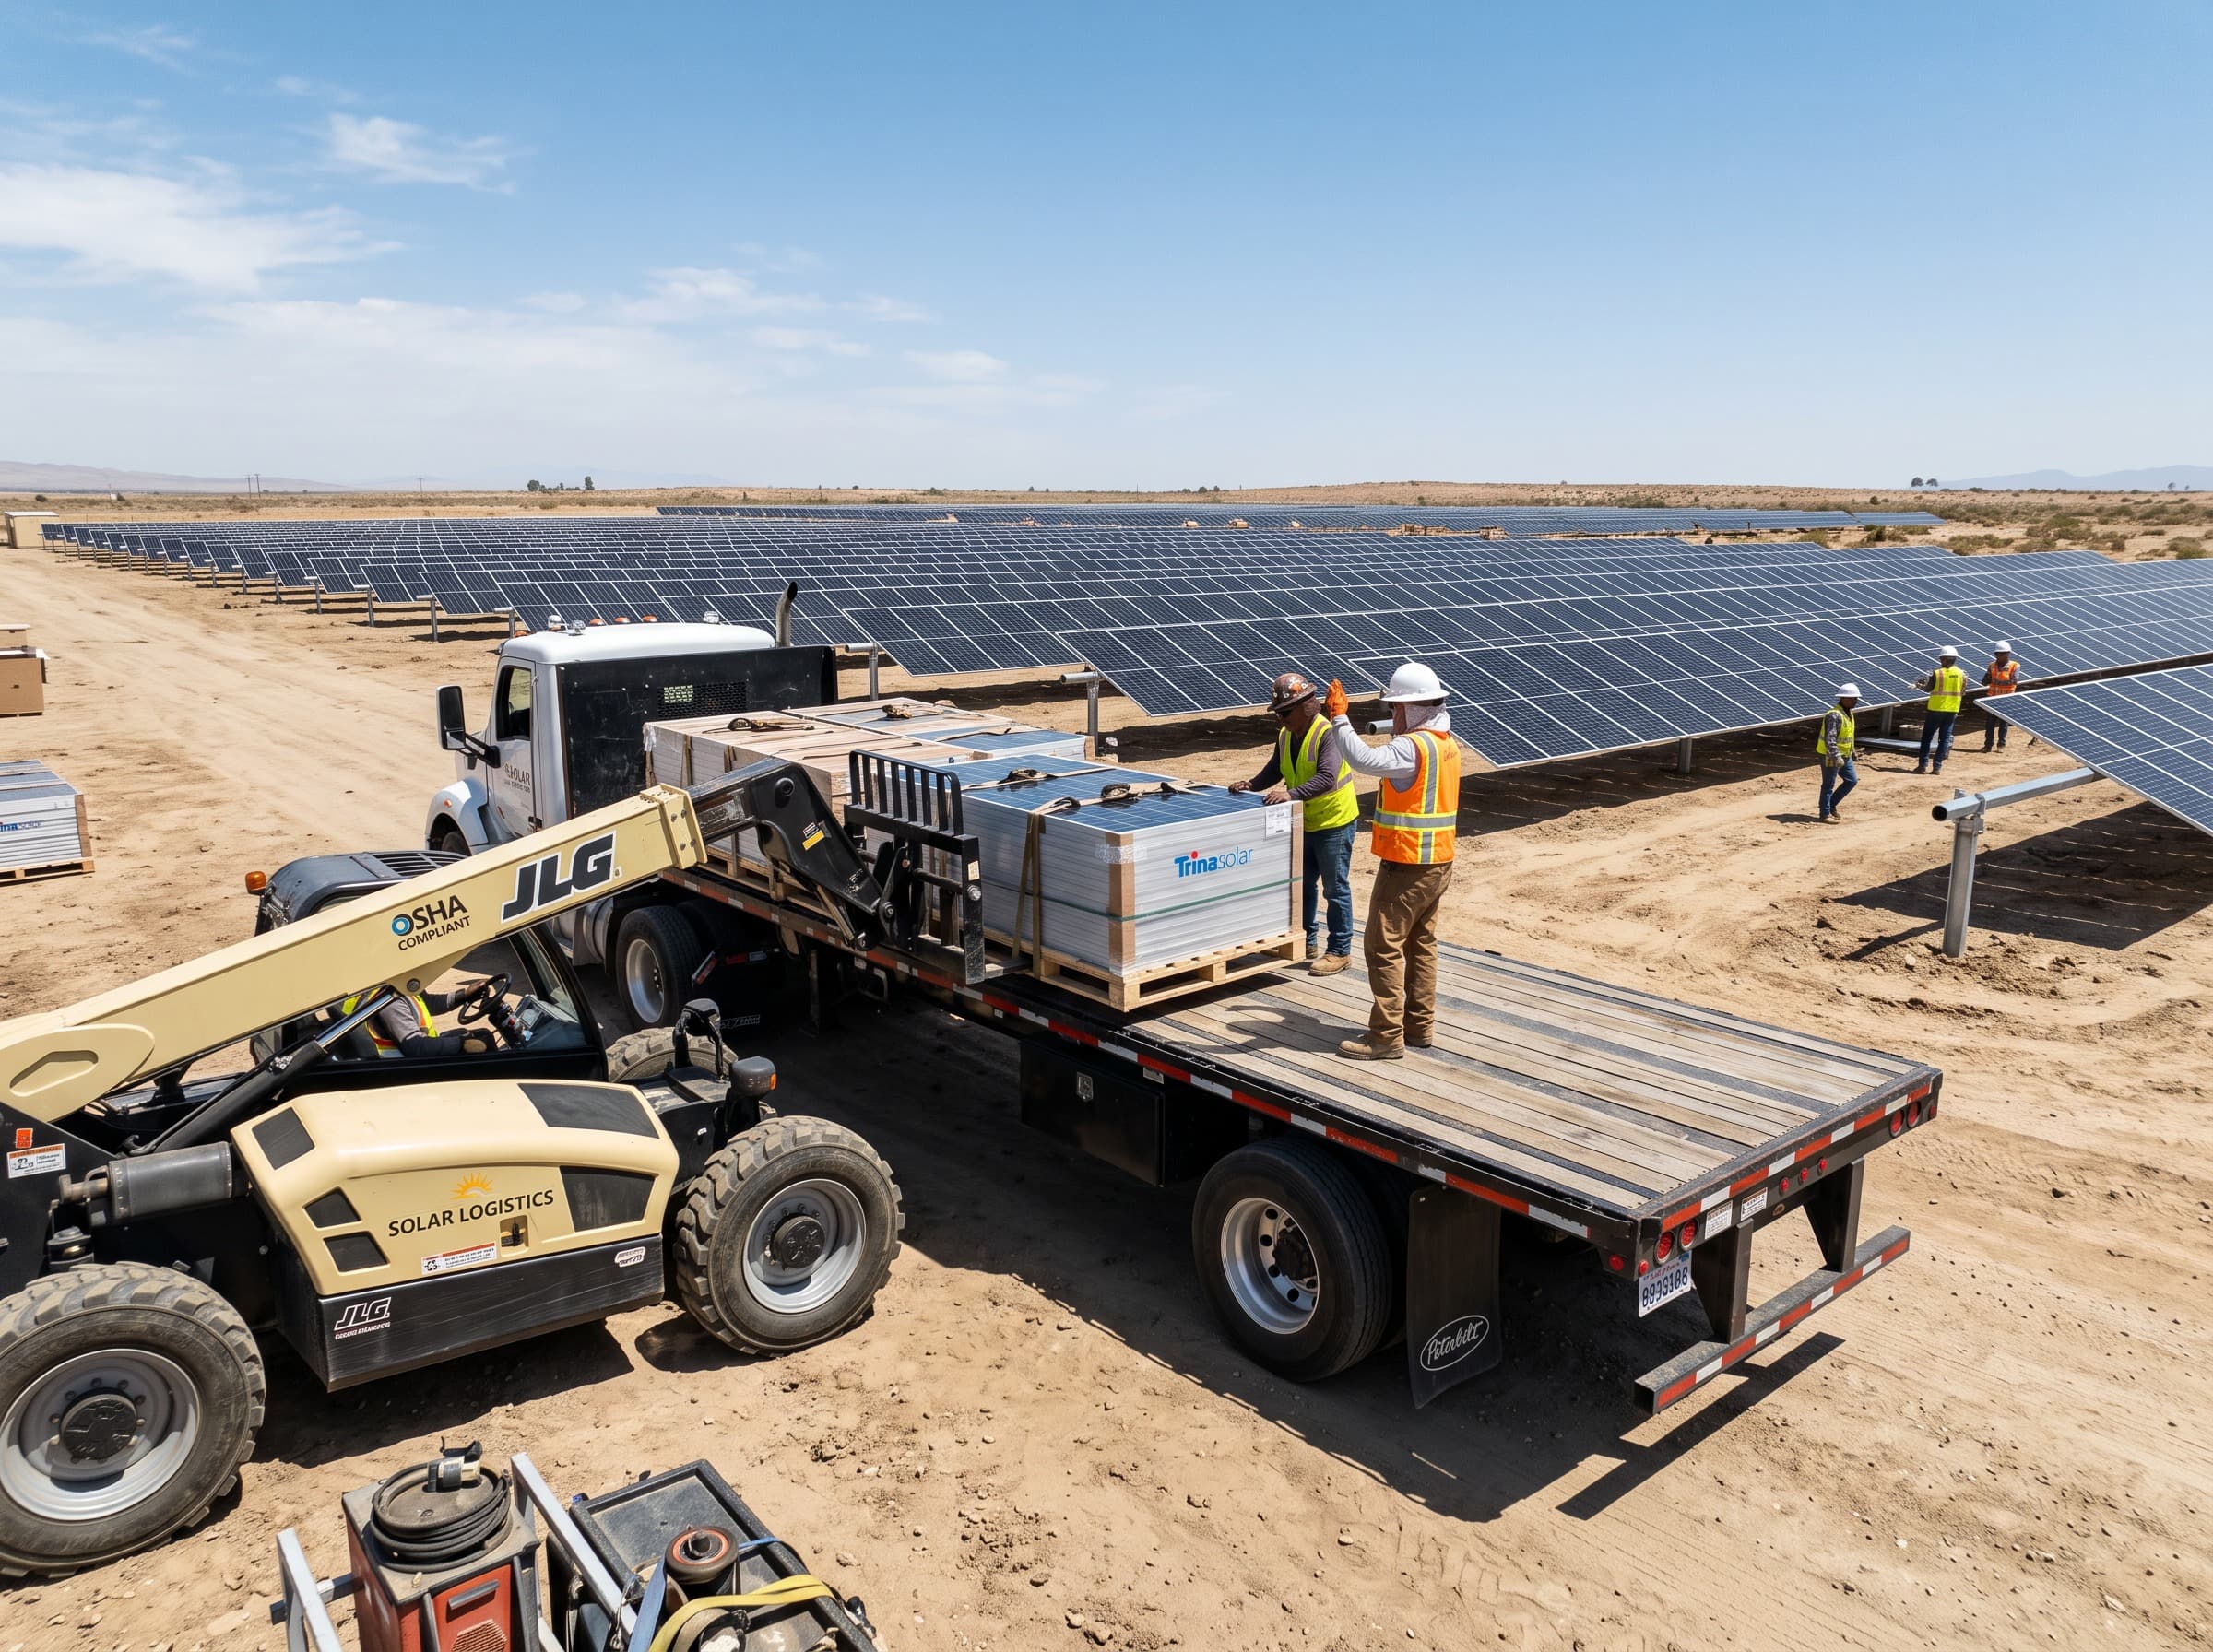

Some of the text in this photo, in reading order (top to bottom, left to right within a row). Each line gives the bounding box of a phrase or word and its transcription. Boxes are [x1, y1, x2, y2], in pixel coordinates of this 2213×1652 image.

[501, 831, 617, 923] JLG
[1174, 846, 1254, 878] Trinasolar
[392, 895, 467, 937] OSHA
[398, 916, 471, 950] COMPLIANT
[388, 1189, 554, 1237] SOLAR LOGISTICS
[334, 1297, 392, 1331] JLG
